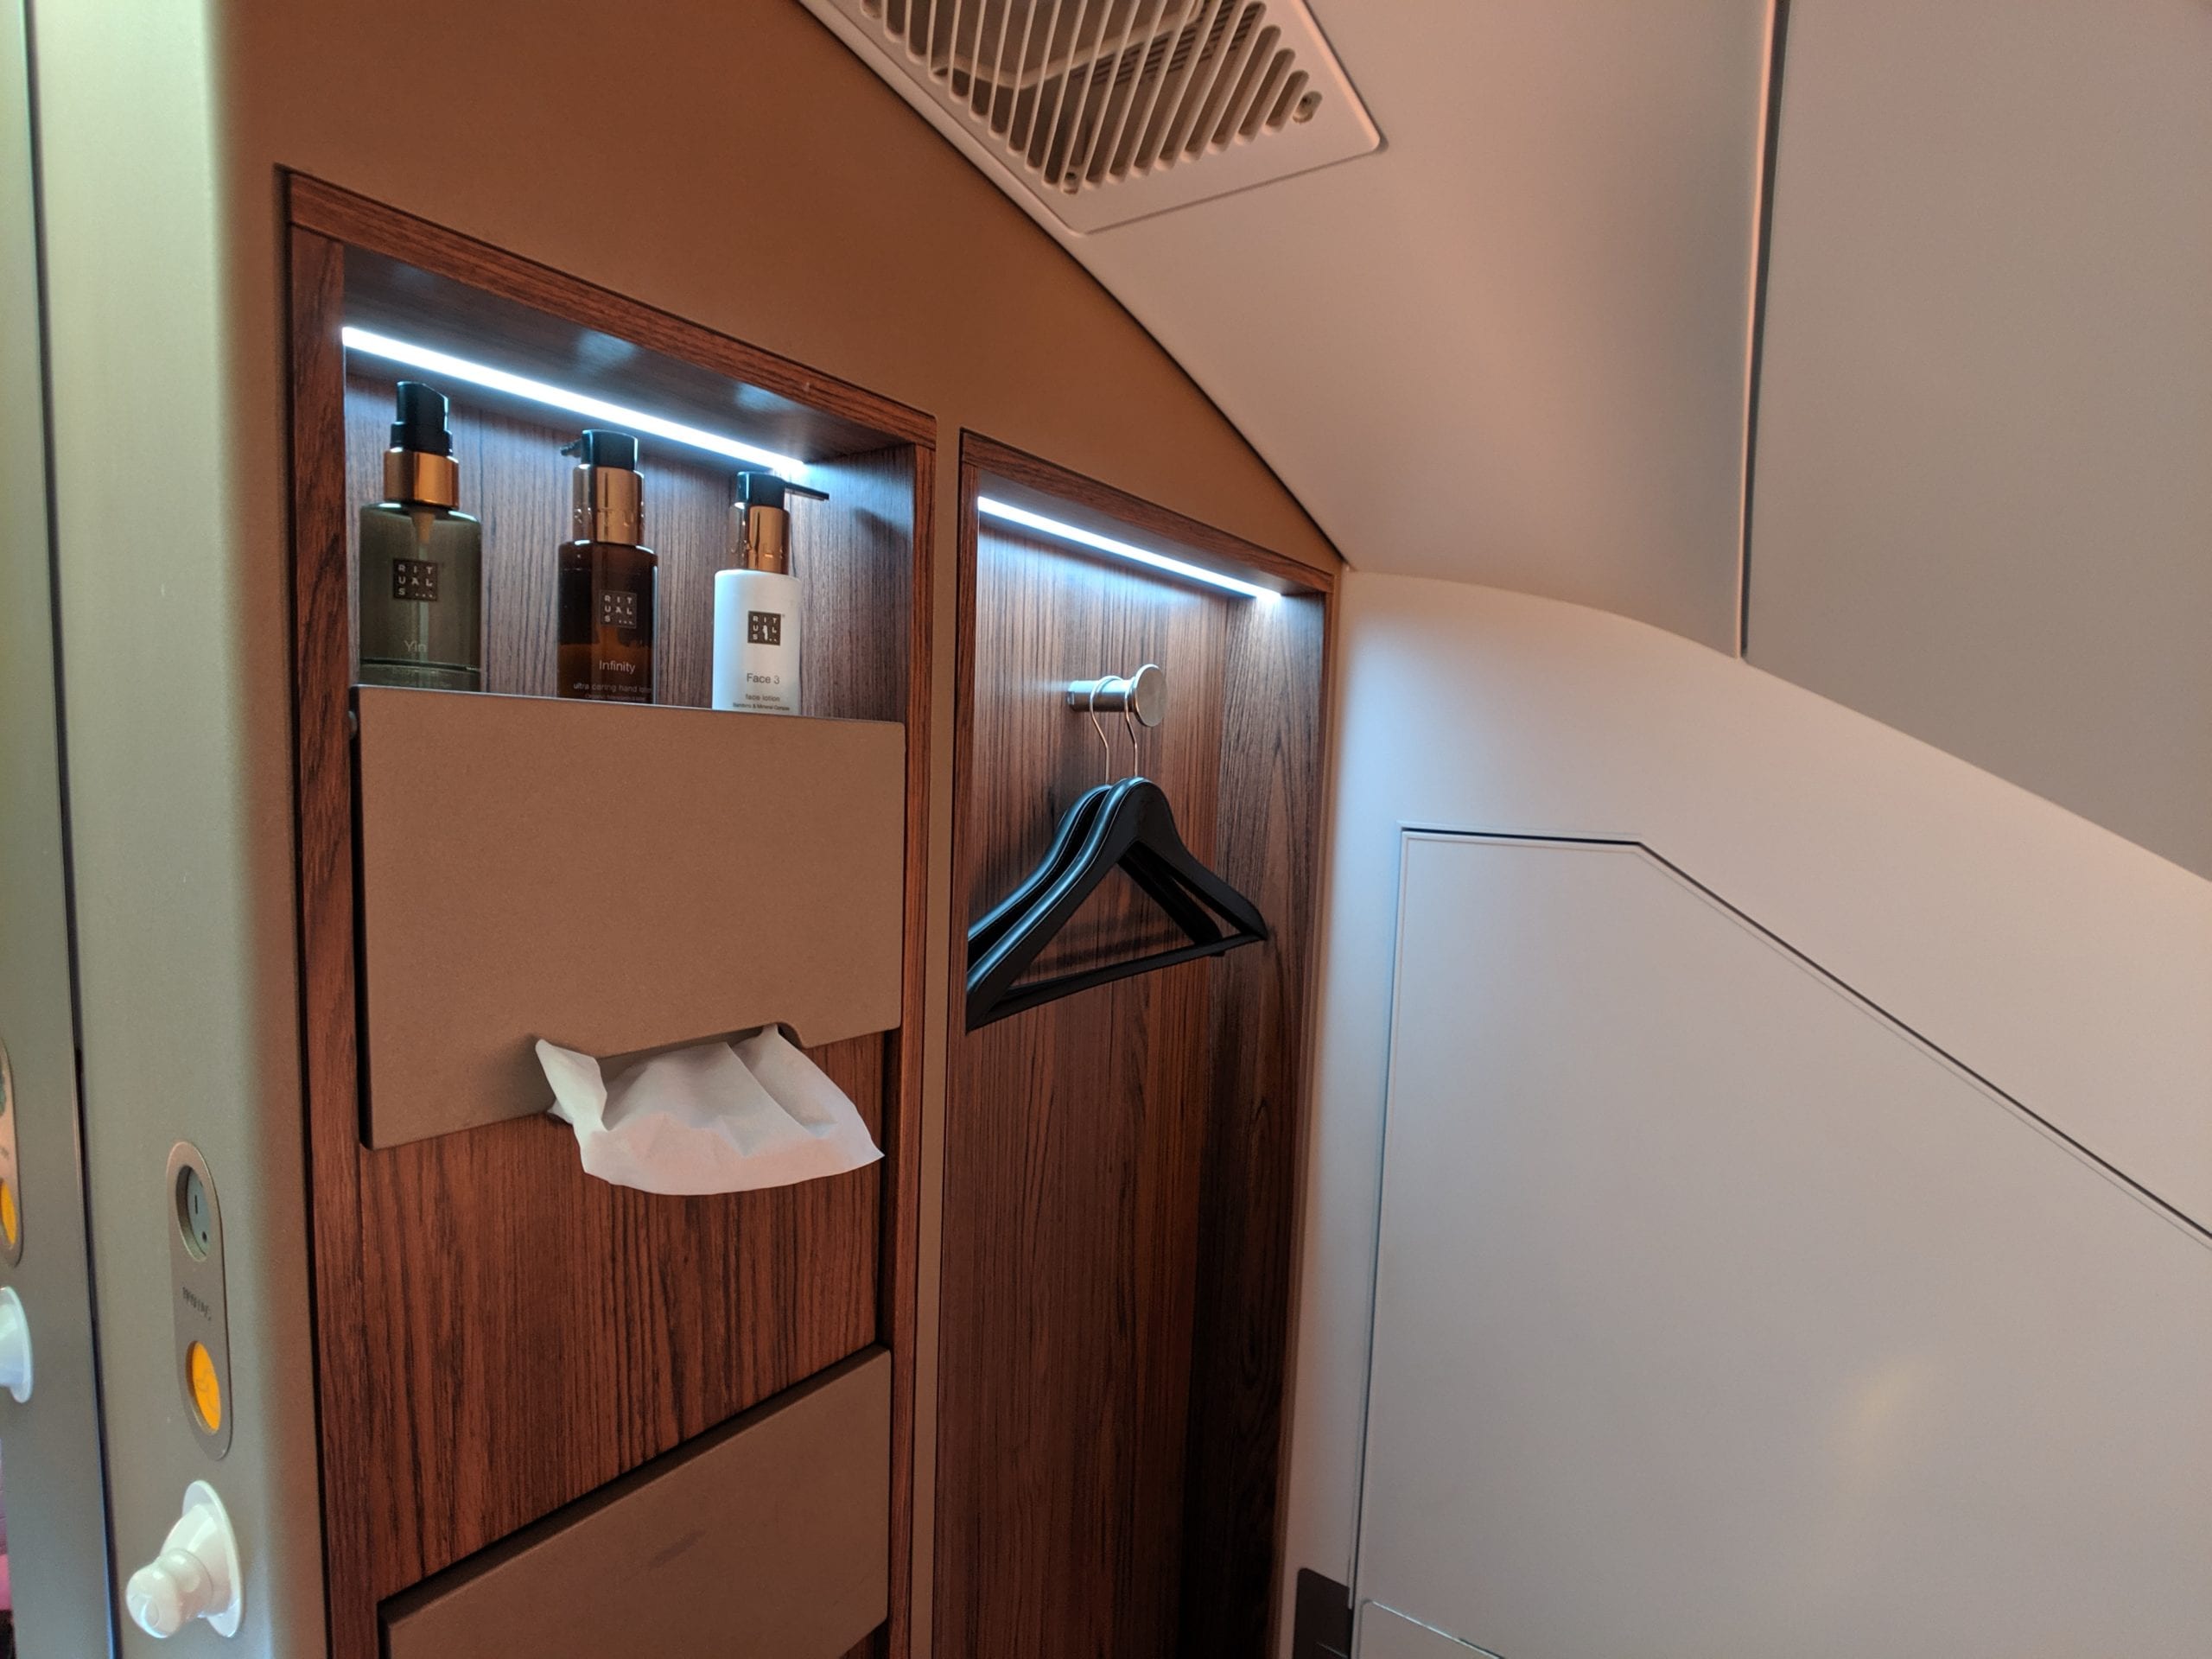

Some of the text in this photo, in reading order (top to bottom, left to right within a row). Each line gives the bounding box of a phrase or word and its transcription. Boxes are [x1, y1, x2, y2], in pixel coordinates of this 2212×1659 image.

[404, 640, 428, 652] Yin
[599, 659, 636, 674] Infinity
[747, 672, 780, 684] Face 3
